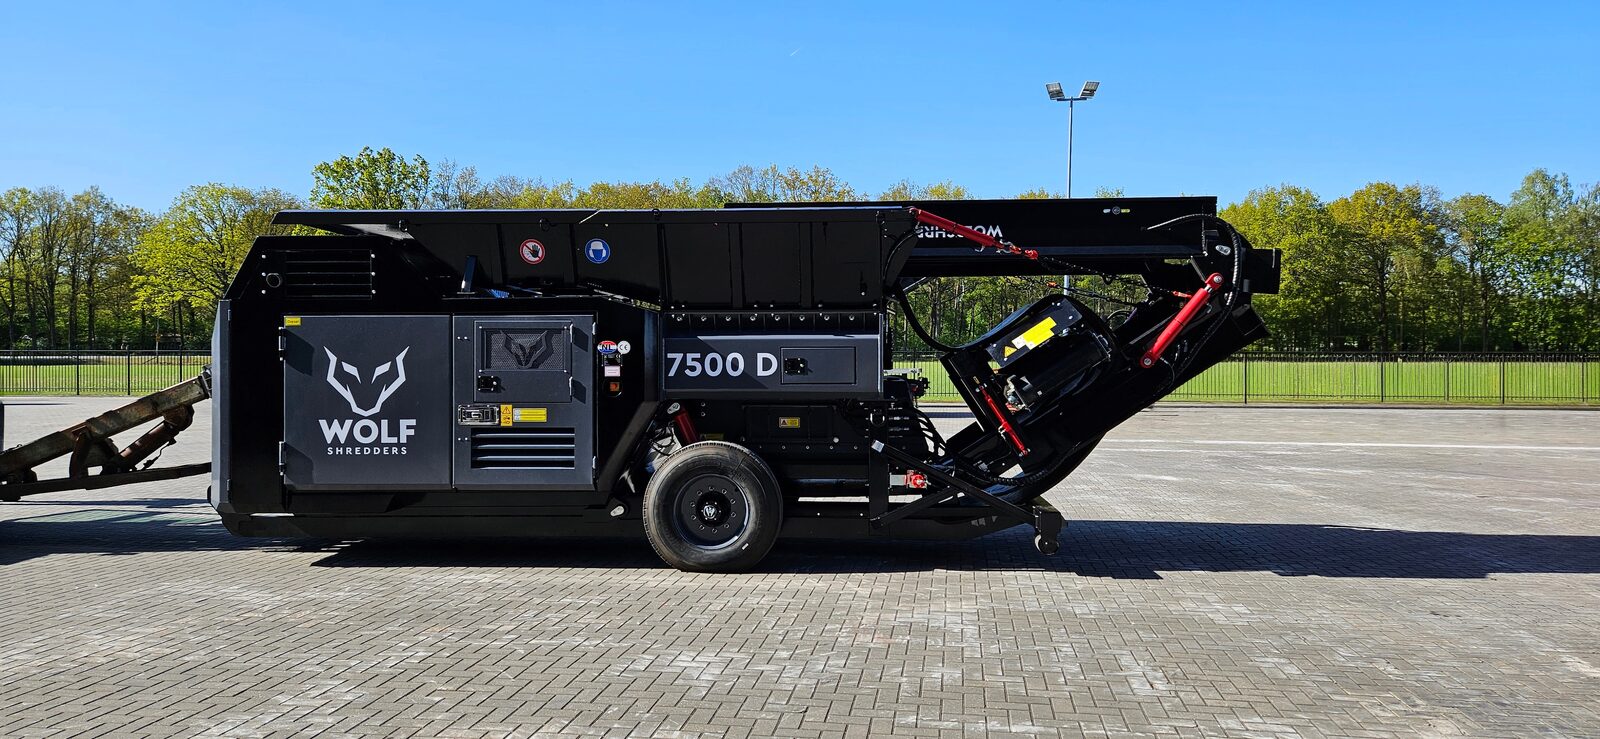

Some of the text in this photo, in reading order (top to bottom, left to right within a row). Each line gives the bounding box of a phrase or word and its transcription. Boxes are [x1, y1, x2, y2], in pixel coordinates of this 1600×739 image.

[666, 352, 778, 377] 7500 D
[318, 419, 417, 444] WOLF
[327, 447, 407, 455] SHREDDERS
